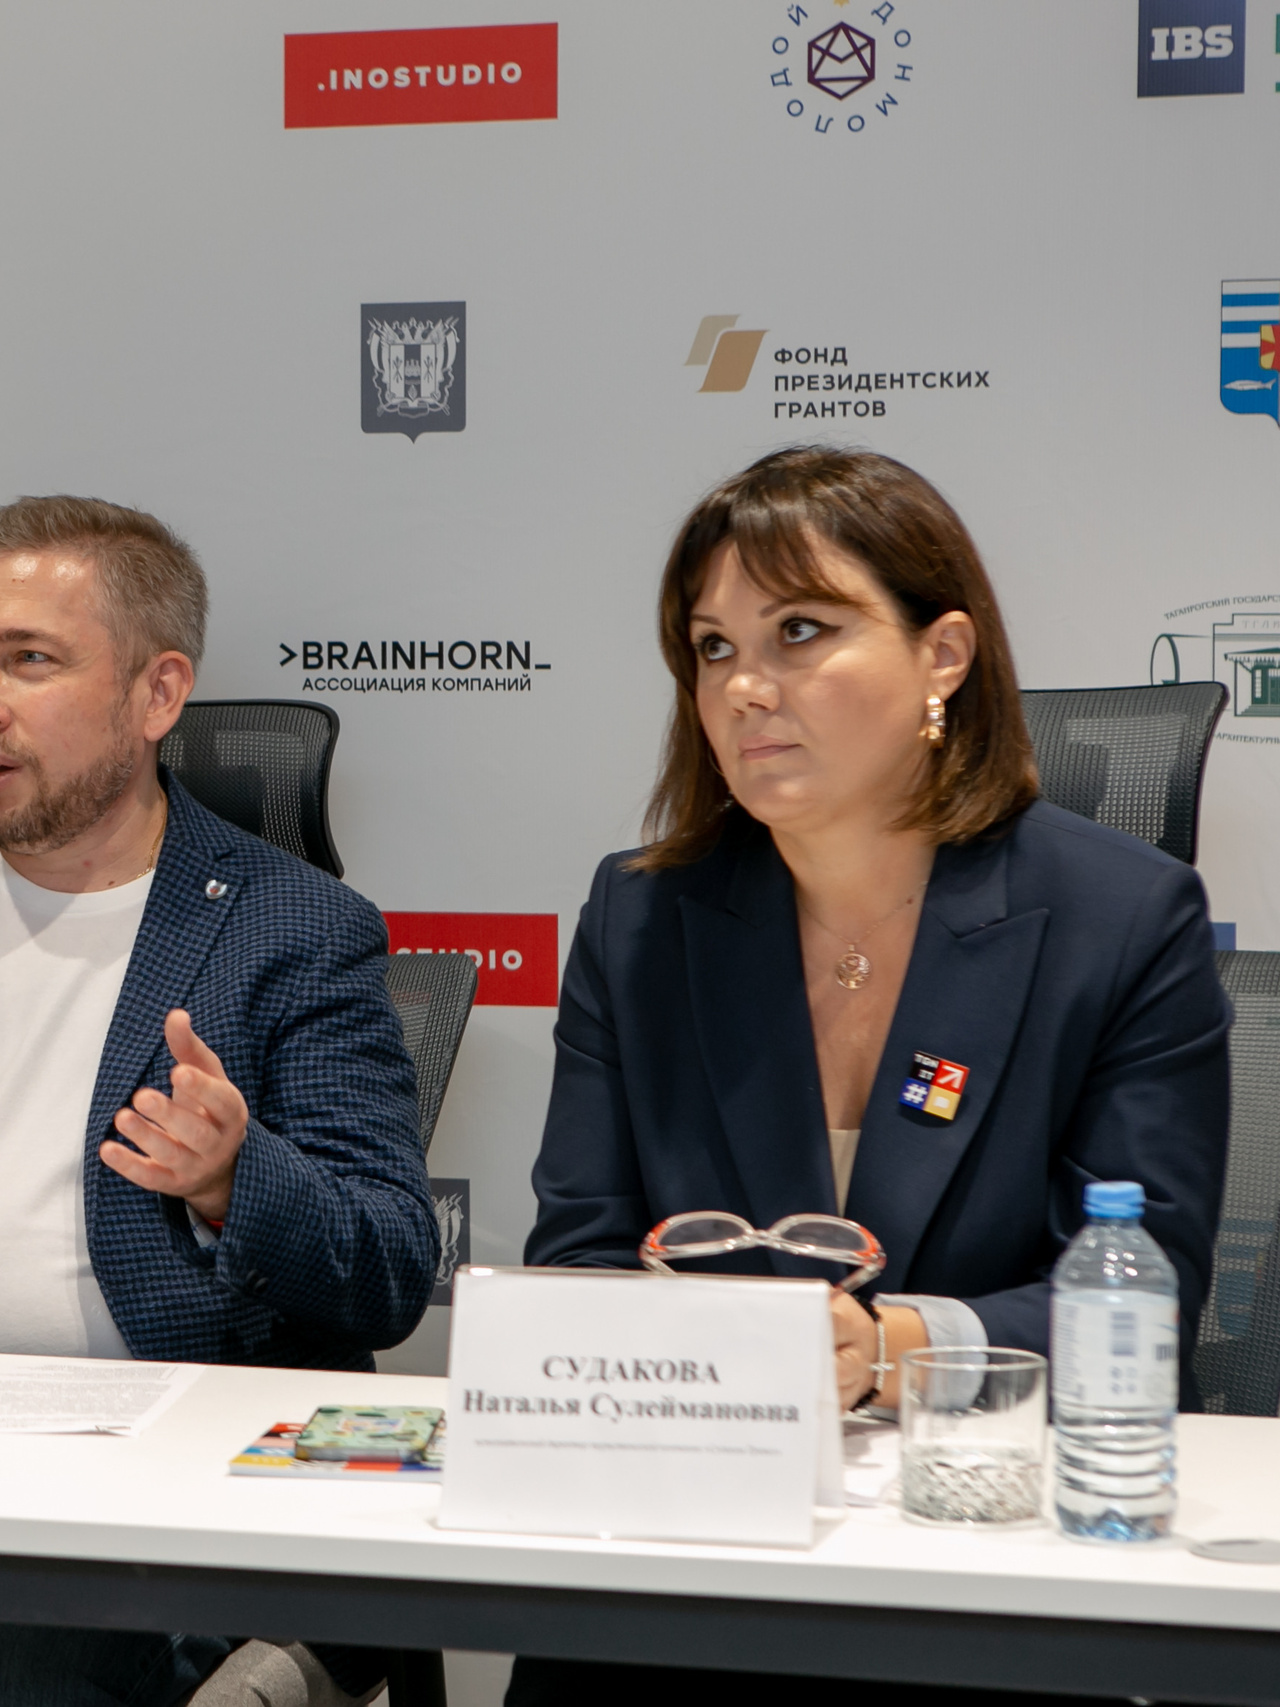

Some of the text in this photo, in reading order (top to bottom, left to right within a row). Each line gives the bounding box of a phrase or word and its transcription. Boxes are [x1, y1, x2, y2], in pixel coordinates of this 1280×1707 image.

[1151, 24, 1234, 61] IBS
[317, 61, 523, 92] .INOSTUDIO
[773, 346, 848, 366] ФОНД
[774, 370, 990, 393] ПРЕЗИДЕНТСКИХ
[774, 400, 887, 419] ГРАНТОВ
[1233, 594, 1280, 605] ГОСУДАРС
[302, 673, 532, 694] АССОЦИАЦИЯ КОМПАНИЙ
[542, 1355, 721, 1384] СУДАКОВА
[463, 1389, 801, 1424] Наталья Сулеймановна
